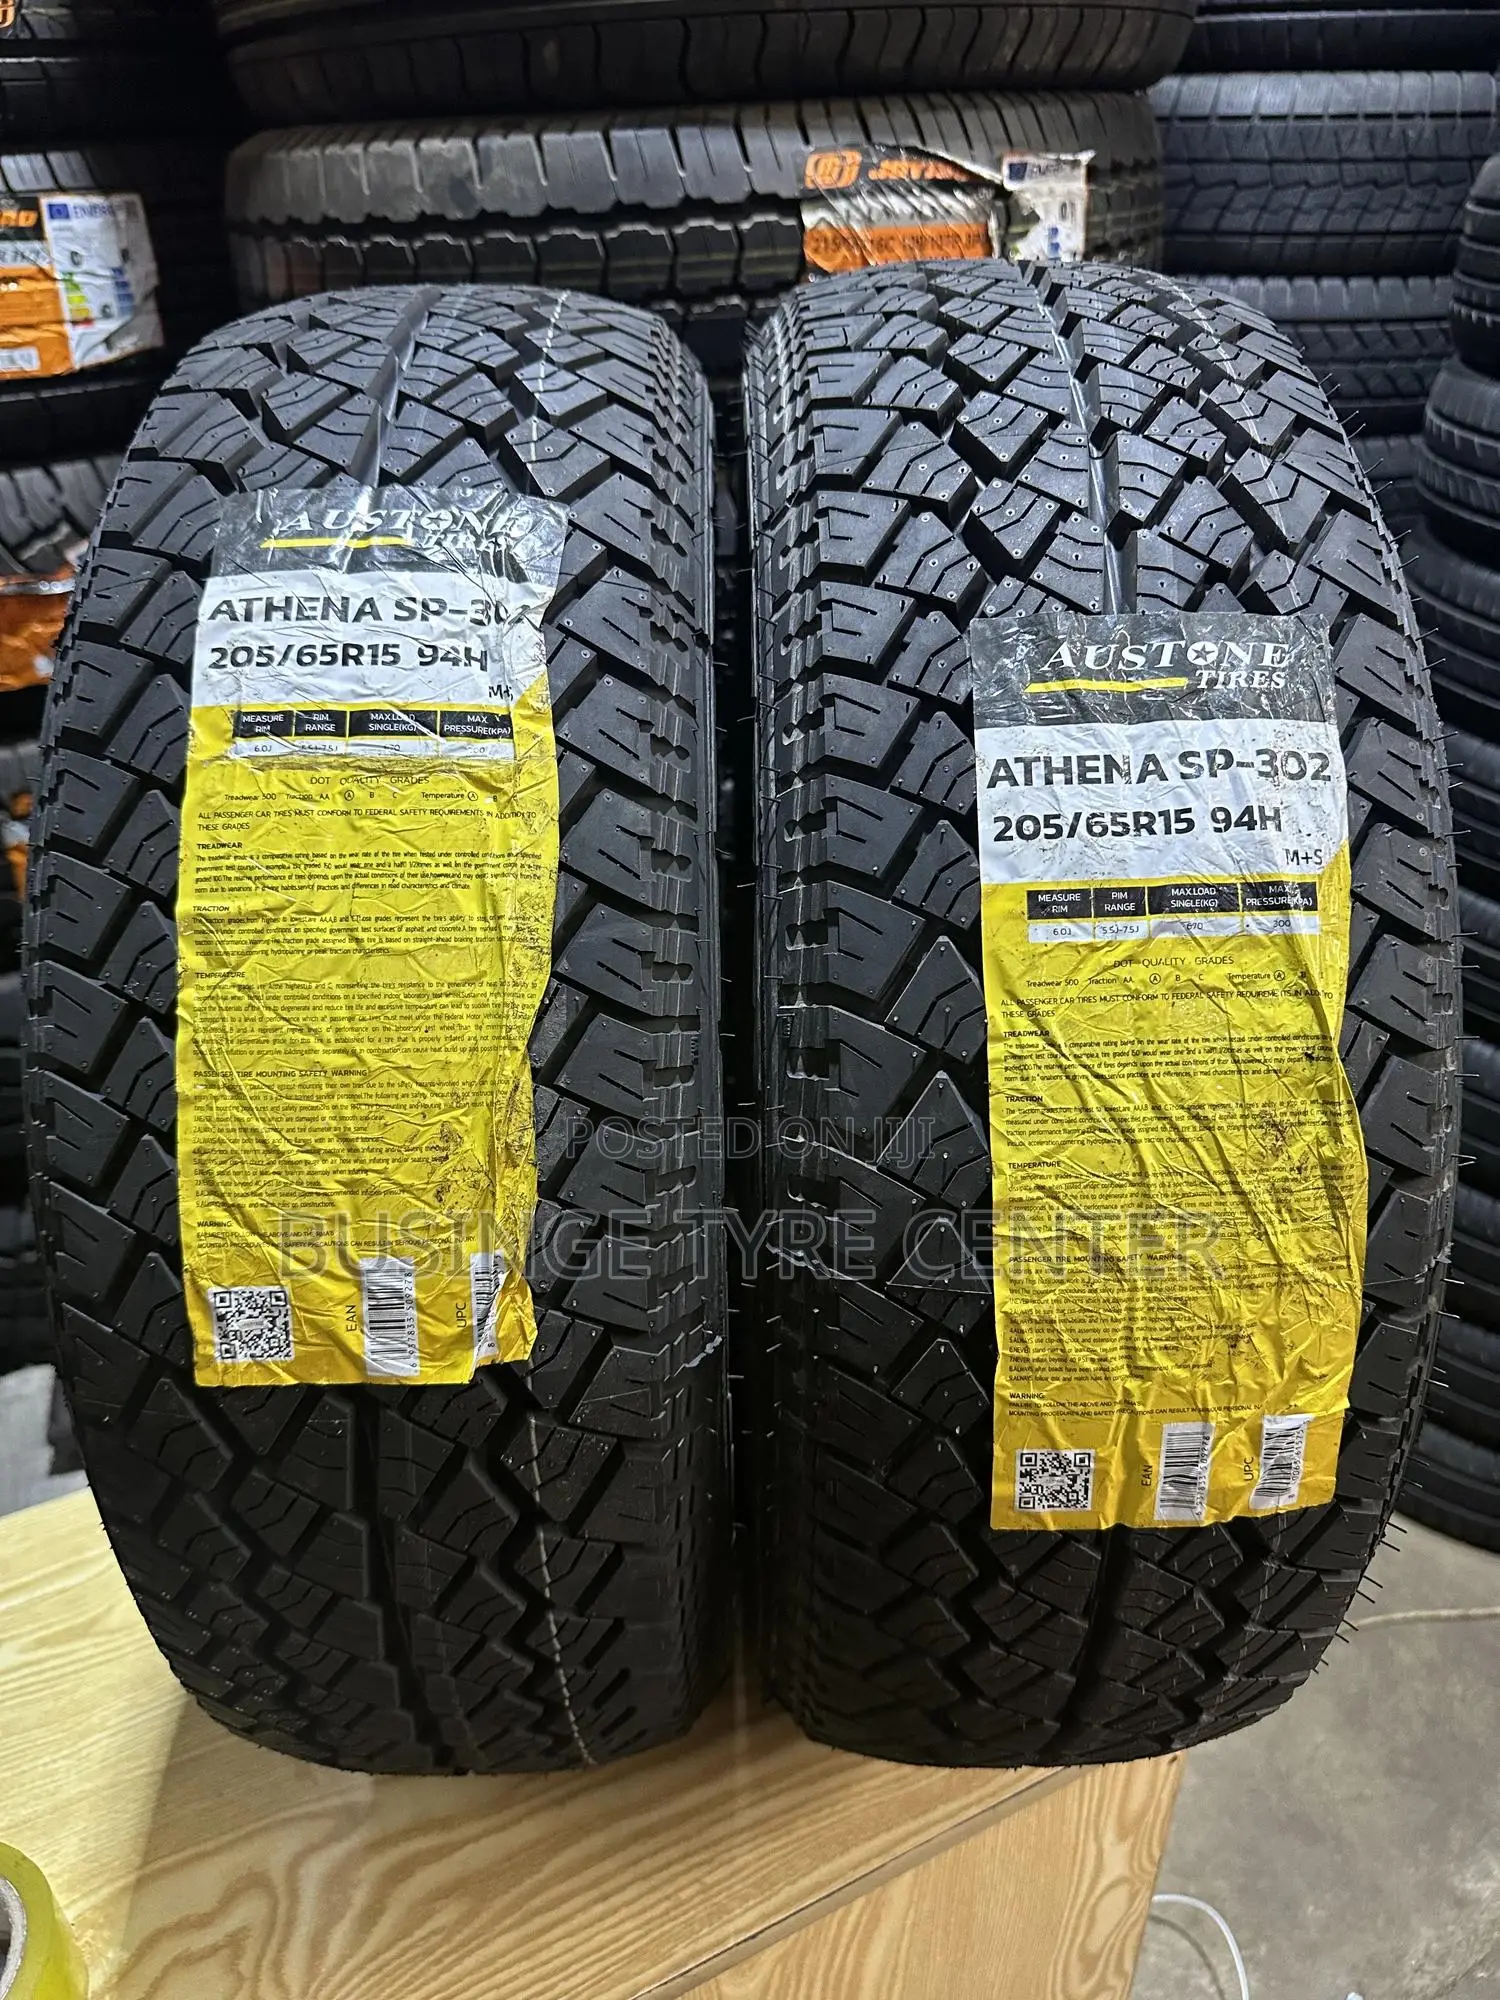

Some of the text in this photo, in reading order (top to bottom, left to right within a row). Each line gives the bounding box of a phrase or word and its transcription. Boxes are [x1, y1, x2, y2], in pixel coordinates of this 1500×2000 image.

[208, 595, 382, 624] ATHENA
[208, 643, 488, 672] 205/65R15 94H
[1041, 640, 1290, 671] AUSTONE
[1195, 669, 1288, 690] TIRES
[242, 714, 285, 723] MEASURE
[313, 713, 329, 721] RIM
[467, 714, 488, 723] MAX
[255, 723, 511, 735] RIM RANGE SINGLE(KG) PRESSURE(KPA)
[987, 747, 1332, 789] ATHENA SP-302
[390, 776, 430, 785] GRADES
[421, 792, 464, 800] Temperature
[317, 809, 351, 817] CONFORM
[222, 823, 250, 831] GRADES
[993, 805, 1283, 842] 205/65R15 94H
[197, 842, 243, 850] TREADWEAR
[1285, 848, 1323, 866] M+S
[1038, 893, 1081, 902] MEASURE
[1052, 905, 1068, 913] RIM
[1104, 903, 1136, 912] RANGE
[1170, 899, 1218, 908] SINGLE(KG)
[1195, 956, 1234, 965] GRADES
[1027, 980, 1062, 988] Treadwear
[1064, 978, 1079, 986] 500
[1123, 976, 1133, 984] AA
[1227, 973, 1271, 981] Temperature
[1017, 998, 1058, 1006] PASSENGER
[1077, 996, 1097, 1004] TIRES
[1099, 995, 1119, 1003] MUST
[1122, 994, 1158, 1002] CONFORM
[1172, 992, 1204, 1000] FEDERAL
[1207, 991, 1233, 999] SAFETY
[1027, 1010, 1056, 1018] GRADES
[1003, 1030, 1050, 1038] TREADWEAR
[331, 1069, 367, 1077] WARNING
[1005, 1095, 1043, 1103] TRACTION
[1008, 1161, 1061, 1169] TEMPERATURE
[1009, 1255, 1052, 1263] PASSENGER
[1146, 1253, 1183, 1261] WARNING
[404, 1272, 414, 1310] 509278
[346, 1305, 357, 1332] EAN
[456, 1302, 466, 1329] UPC
[1141, 1464, 1152, 1487] EAN
[1244, 1457, 1254, 1481] UPC
